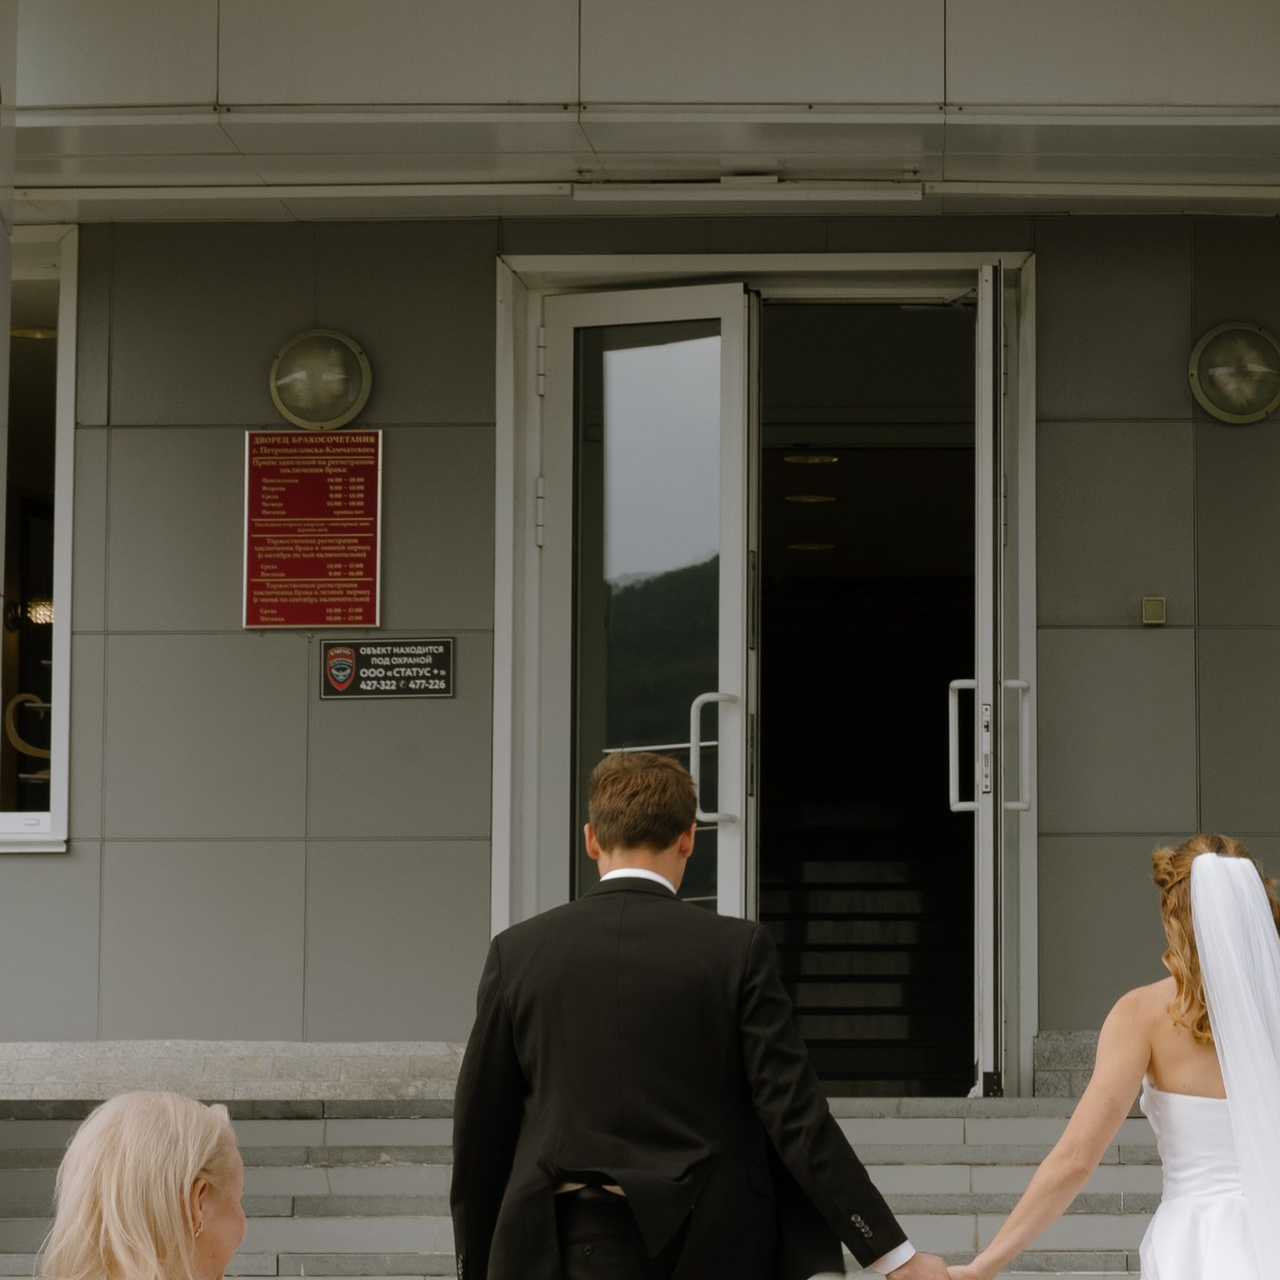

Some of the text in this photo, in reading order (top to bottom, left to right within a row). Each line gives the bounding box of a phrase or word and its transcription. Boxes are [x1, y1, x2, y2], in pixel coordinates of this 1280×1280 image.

[253, 436, 375, 444] ДВОРЕЦ БРАКОСОЧЕТАНИЯ
[360, 646, 444, 655] ОБЪЕКТ НАХОДИТСЯ
[371, 655, 432, 665] ПОД ОХРАНОЙ
[360, 668, 385, 677] ООО
[360, 680, 446, 690] 427-322 477-226
